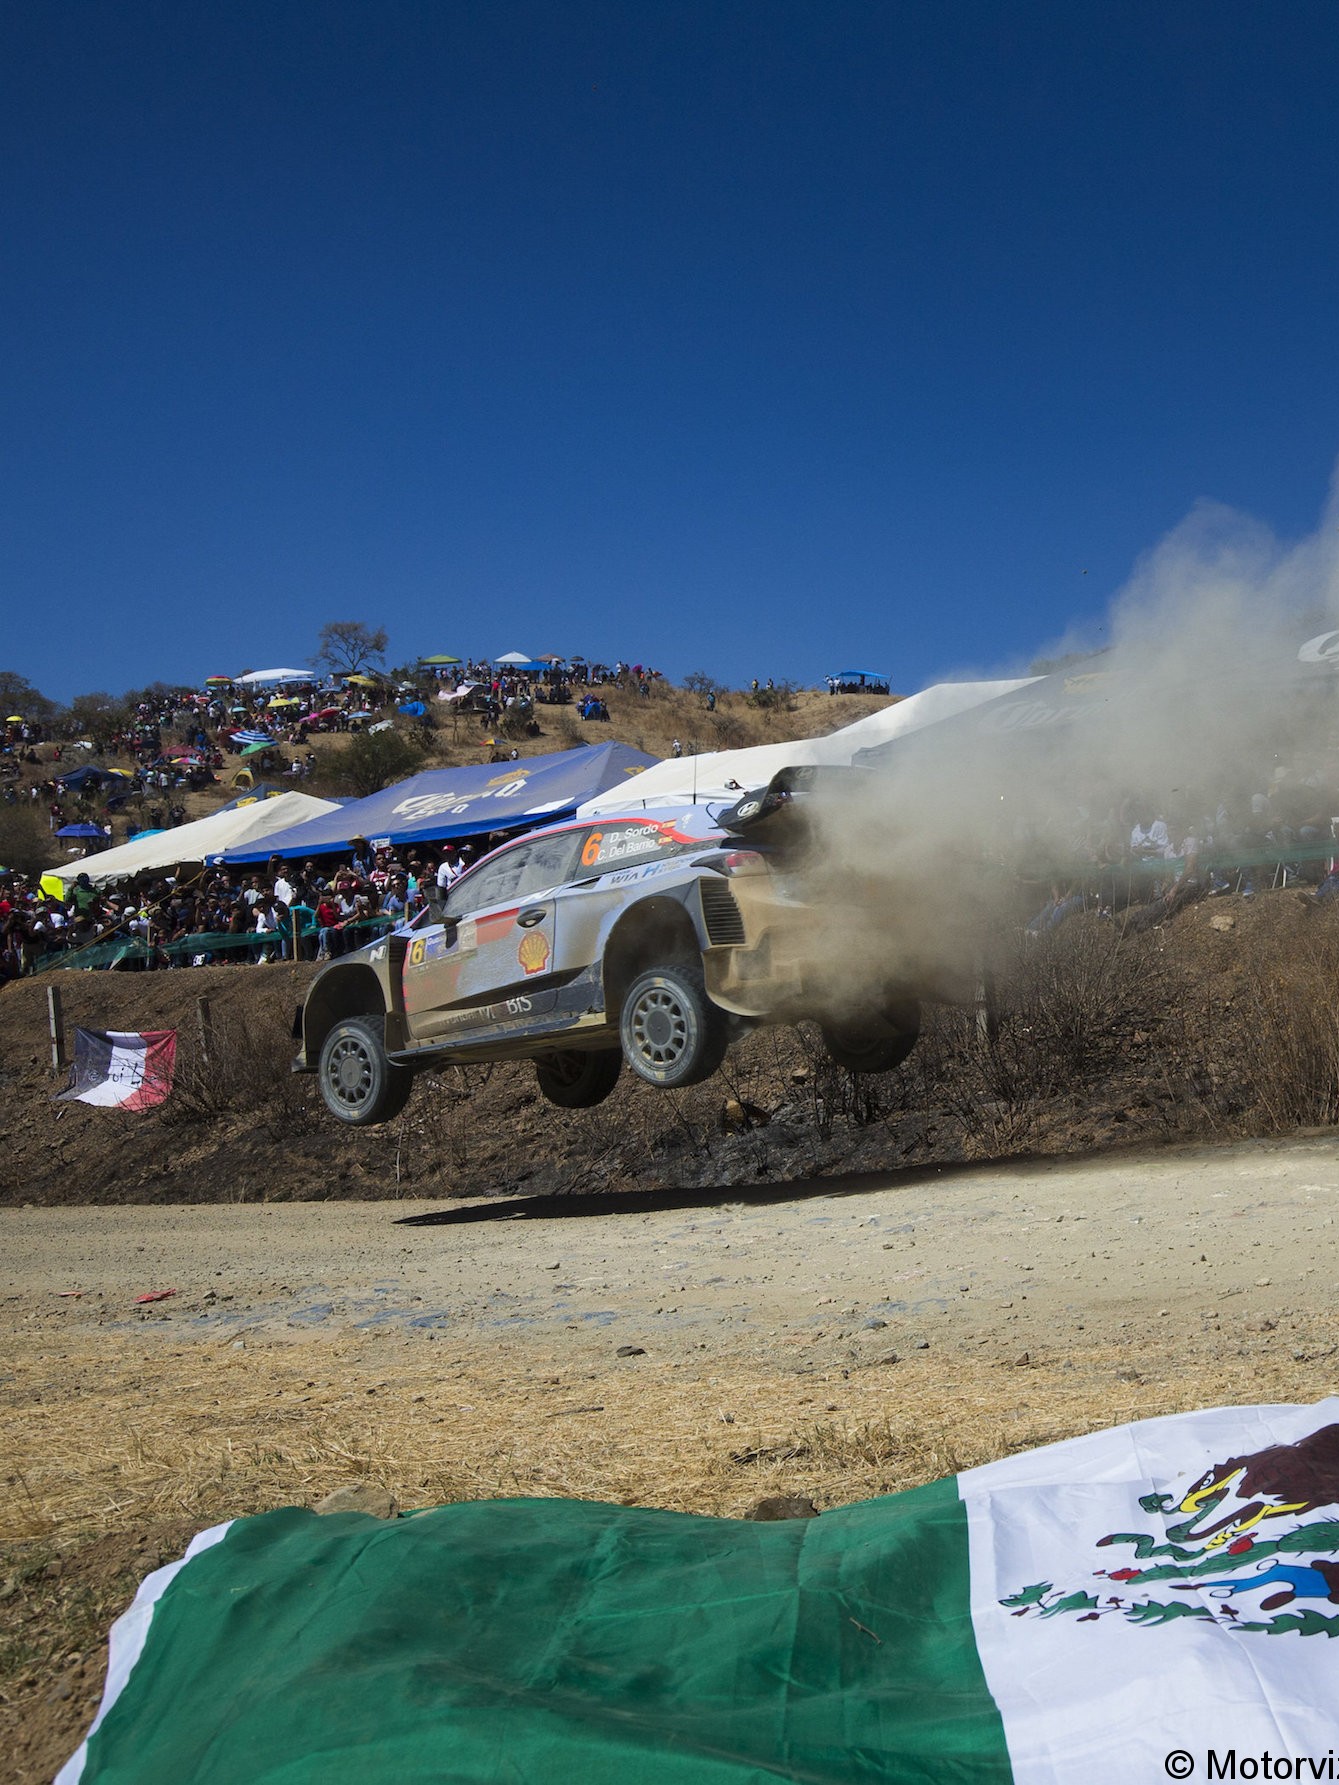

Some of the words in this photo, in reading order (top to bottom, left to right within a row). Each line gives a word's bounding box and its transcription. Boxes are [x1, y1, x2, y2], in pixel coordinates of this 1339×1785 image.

[610, 832, 619, 844] D.
[624, 824, 659, 840] Sordo
[581, 832, 603, 866] 6
[597, 849, 607, 861] C.
[609, 846, 625, 858] Del
[626, 839, 656, 857] Barrio
[411, 940, 425, 964] 6
